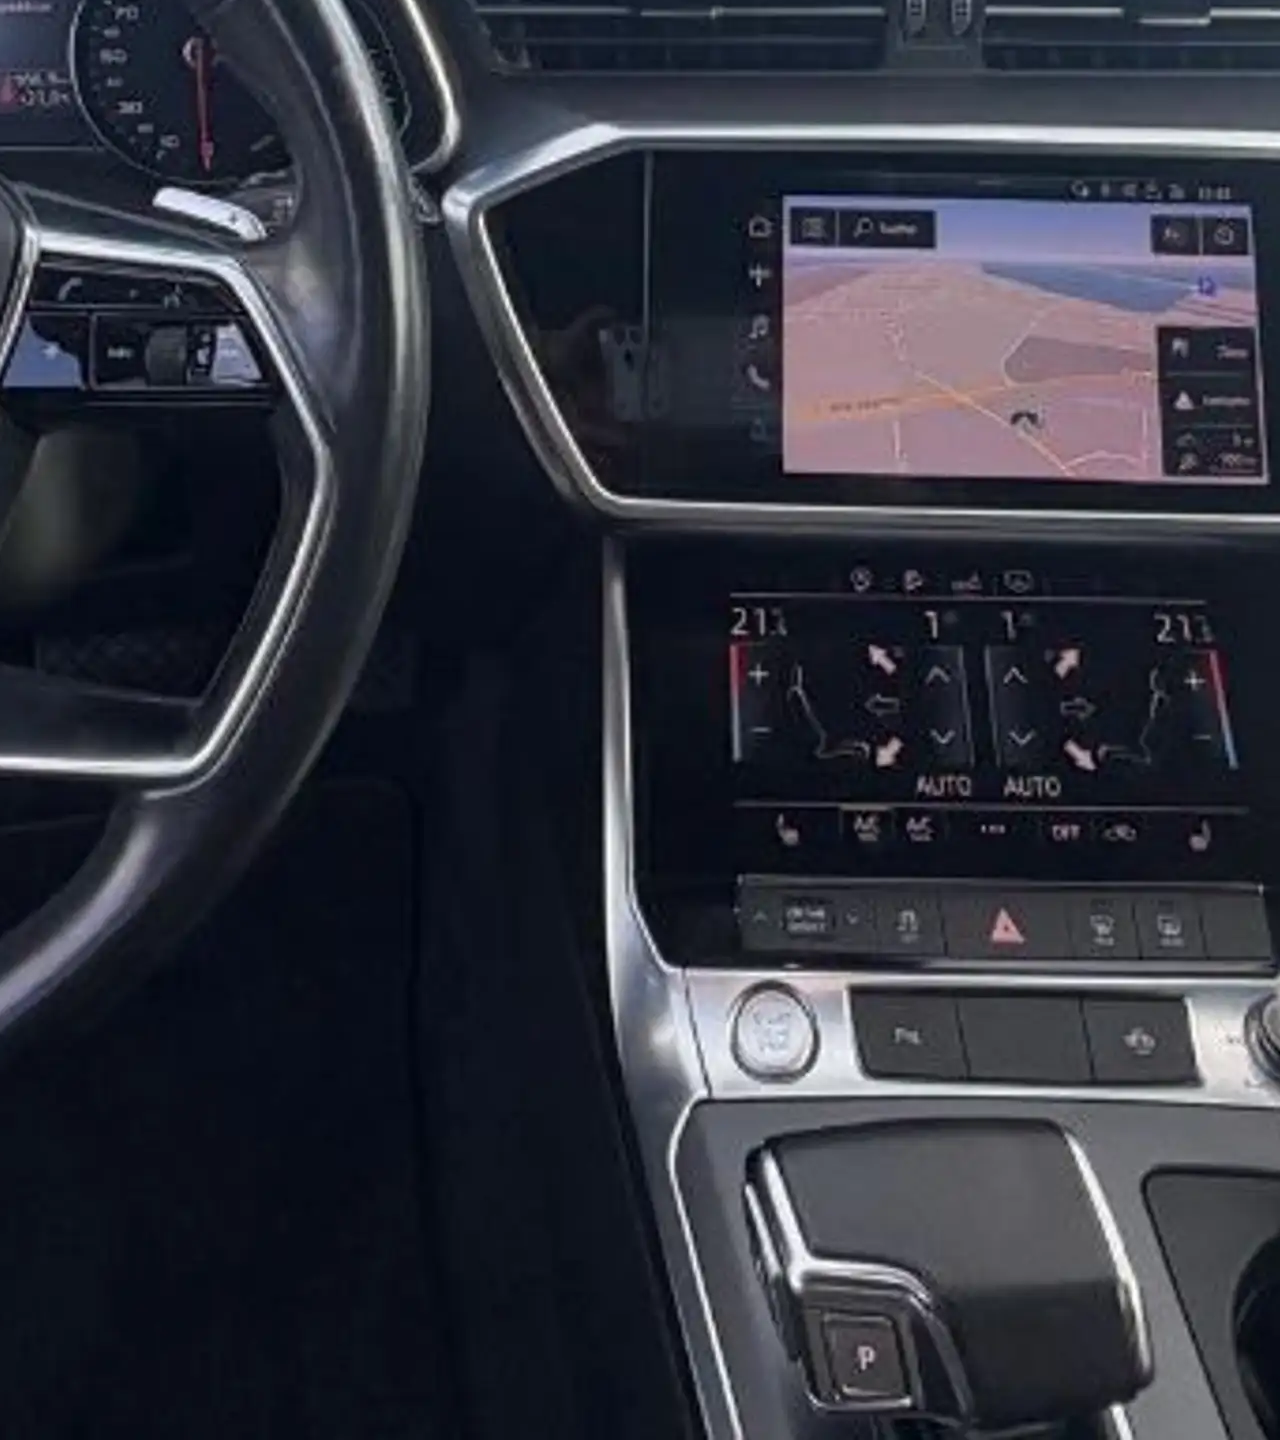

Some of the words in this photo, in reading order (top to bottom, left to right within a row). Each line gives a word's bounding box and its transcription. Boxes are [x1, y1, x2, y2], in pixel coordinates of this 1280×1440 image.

[917, 776, 972, 798] AUTO
[1003, 776, 1062, 798] AUTO
[857, 1345, 876, 1371] P
